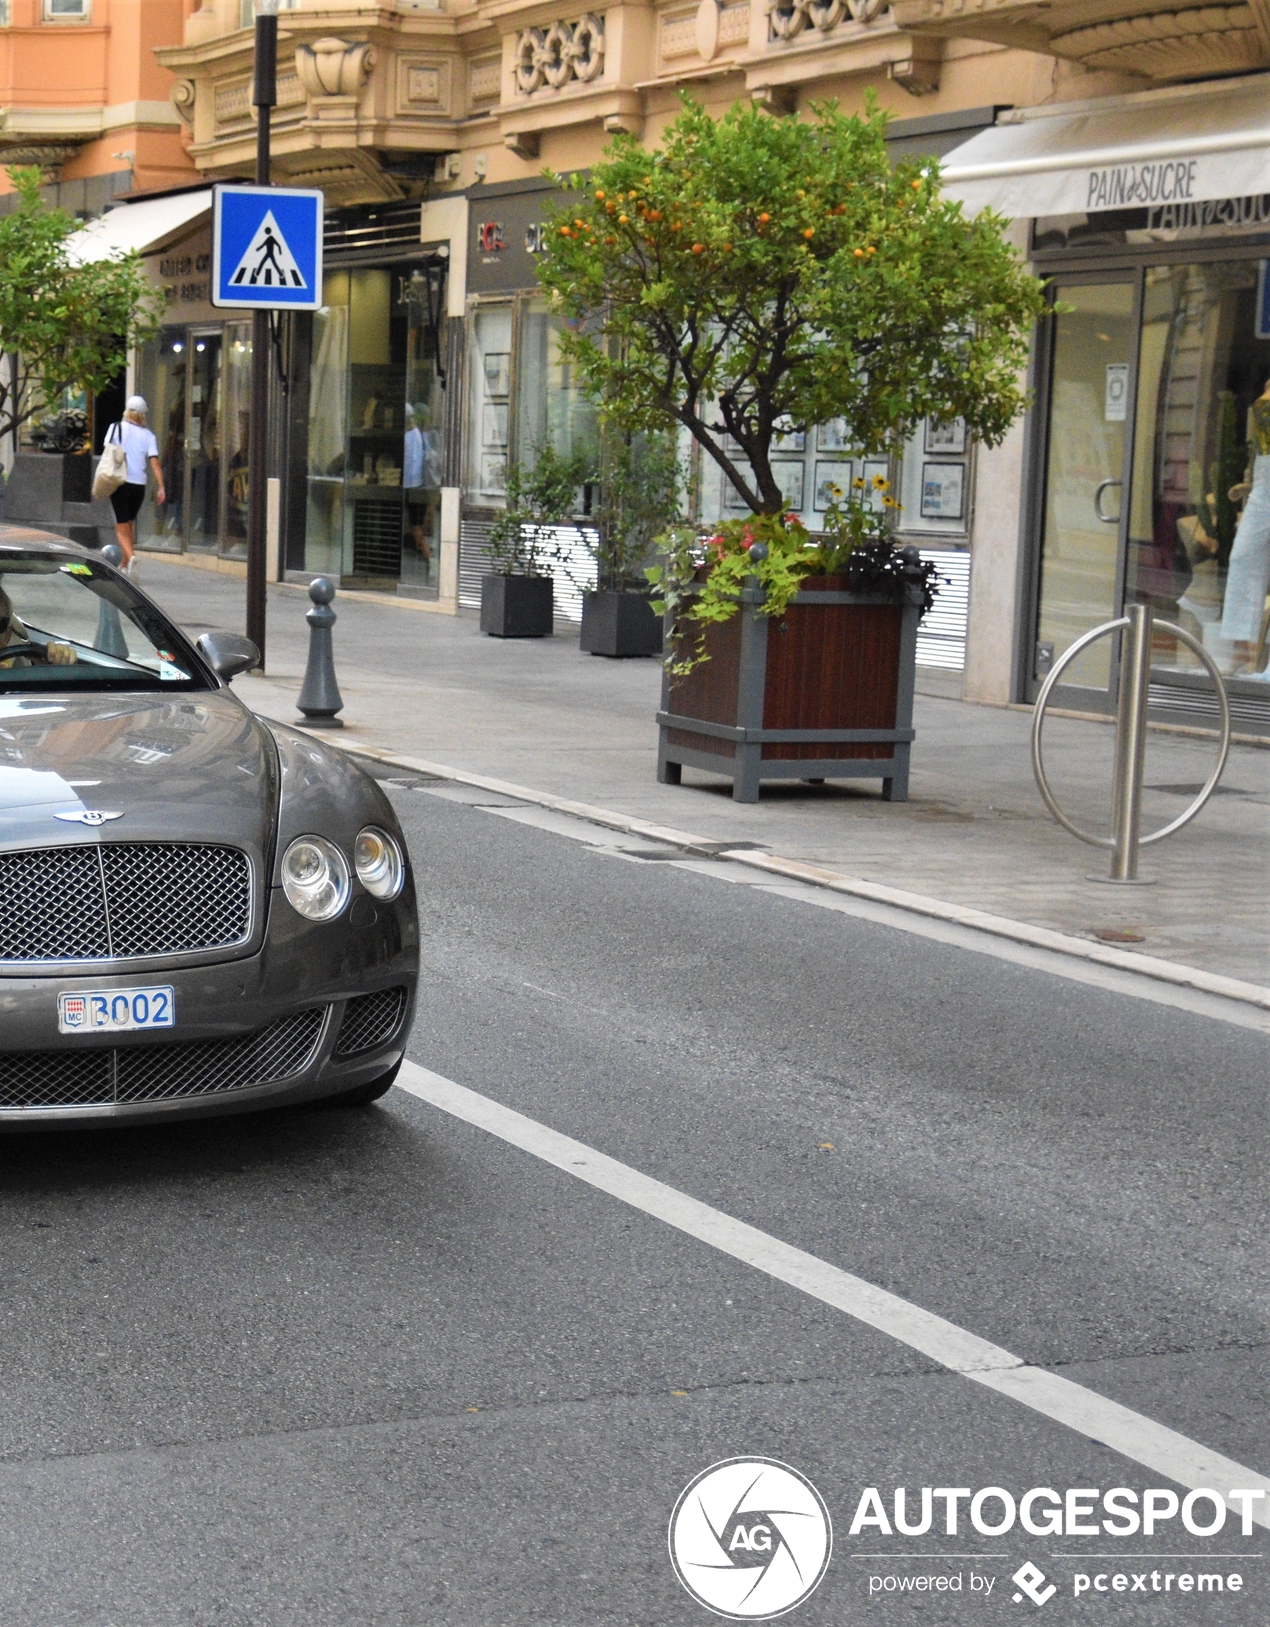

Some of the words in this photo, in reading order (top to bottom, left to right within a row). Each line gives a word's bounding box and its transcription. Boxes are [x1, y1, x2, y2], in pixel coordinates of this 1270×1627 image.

[1086, 167, 1128, 208] PAIN
[1139, 161, 1197, 203] SUCRE
[68, 1013, 82, 1022] MC
